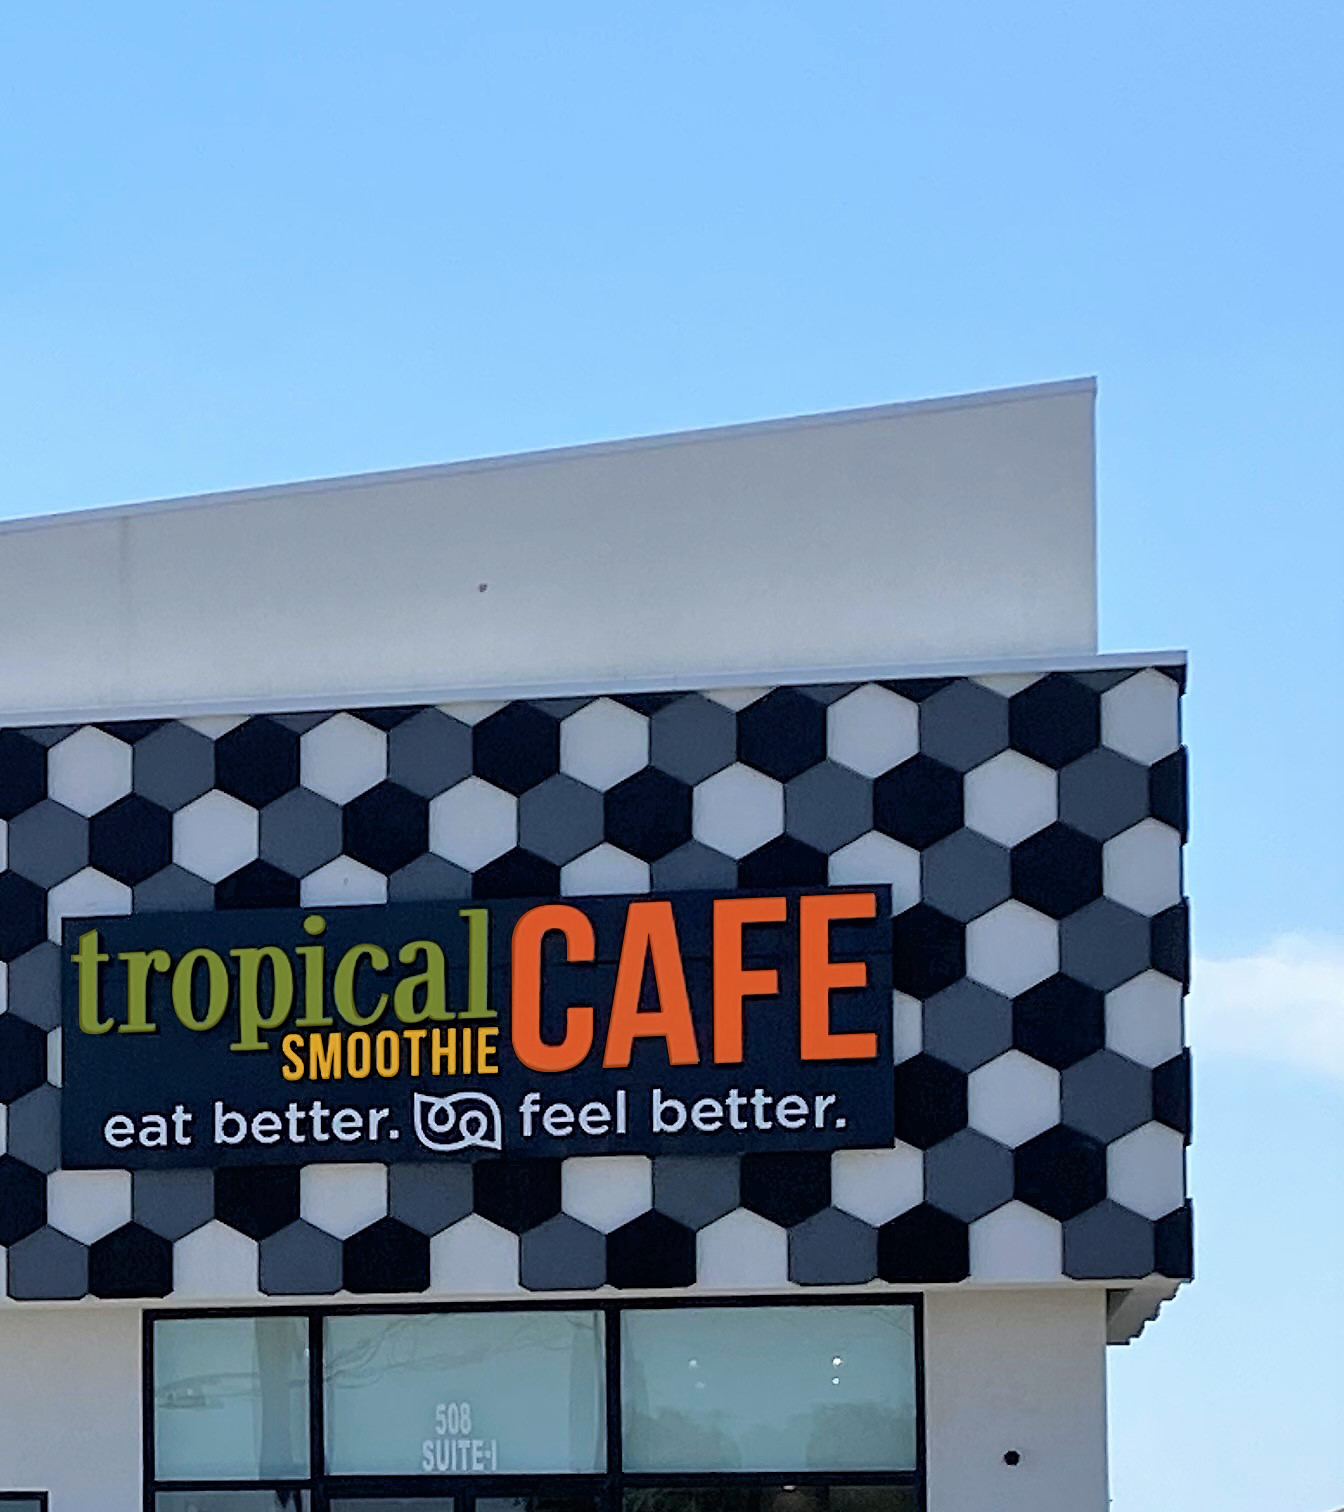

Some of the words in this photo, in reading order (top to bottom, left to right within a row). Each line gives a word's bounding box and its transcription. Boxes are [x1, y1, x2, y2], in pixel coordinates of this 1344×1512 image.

[70, 908, 498, 1051] tropical
[512, 892, 877, 1073] CAFE
[282, 1026, 500, 1081] SMOOTHIE
[104, 1105, 192, 1148] eat
[213, 1099, 400, 1146] better.
[520, 1089, 627, 1138] feel
[651, 1088, 848, 1134] better.
[435, 1402, 472, 1435] 508
[422, 1439, 497, 1471] SUITE-I
